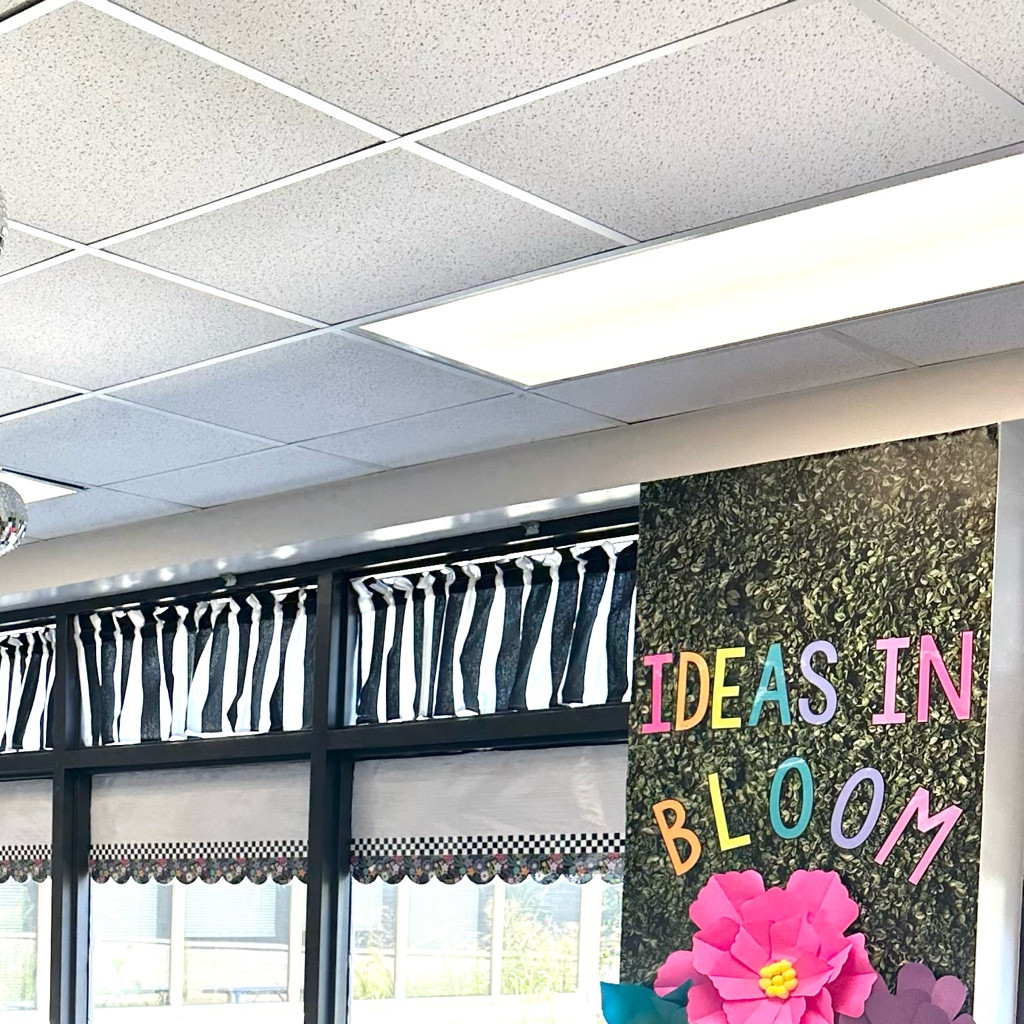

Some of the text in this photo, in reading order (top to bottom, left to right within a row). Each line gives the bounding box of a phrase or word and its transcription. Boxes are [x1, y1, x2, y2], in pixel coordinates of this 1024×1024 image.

[641, 630, 974, 734] IDEAS IN
[652, 756, 962, 885] BLOOM
